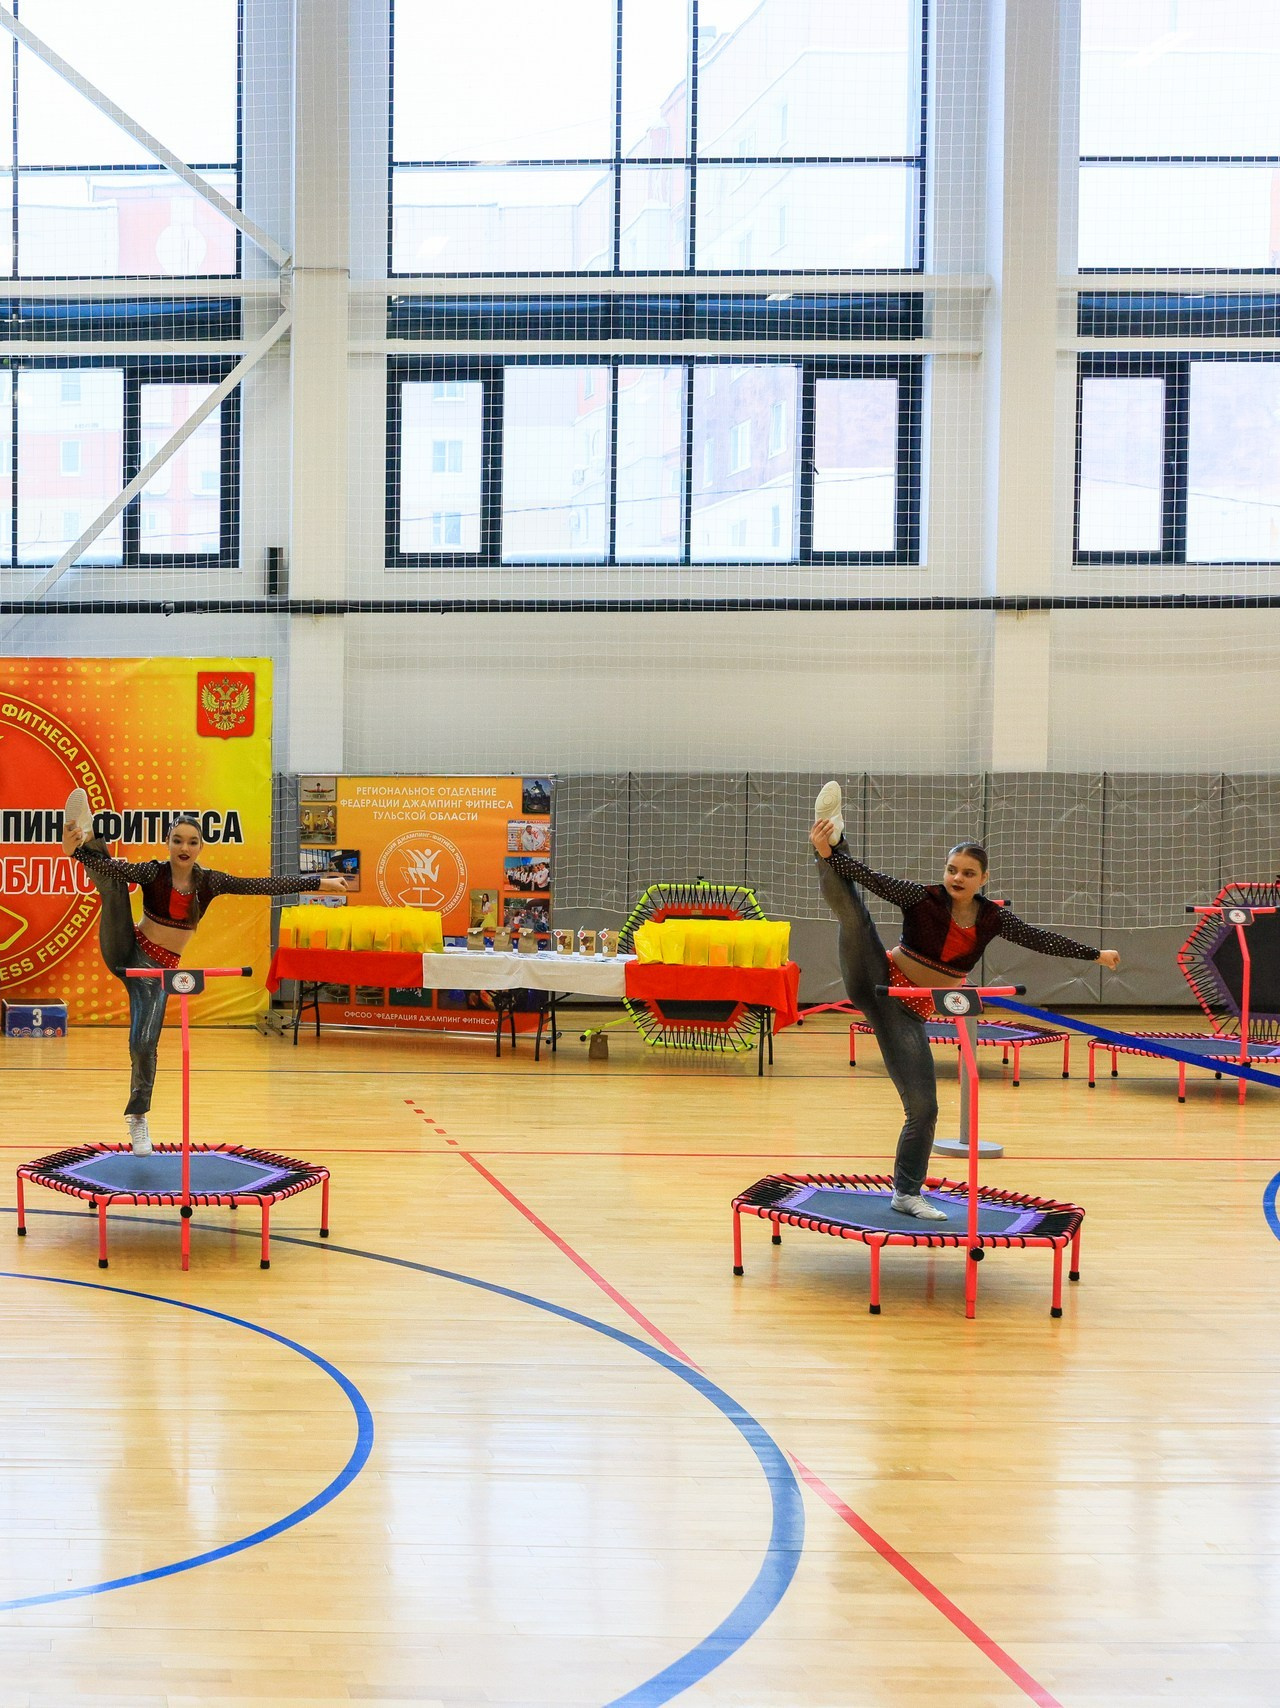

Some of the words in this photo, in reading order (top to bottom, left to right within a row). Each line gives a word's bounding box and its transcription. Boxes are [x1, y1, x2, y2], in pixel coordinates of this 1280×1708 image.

[1, 702, 80, 761] ФИТНЕСА
[76, 761, 107, 812] РОСС
[356, 786, 435, 796] РЕГИОНАЛЬНОЕ
[437, 787, 497, 797] ОТДЕЛЕНИЕ
[340, 799, 400, 809] ФЕДЕРАЦИИ
[402, 799, 463, 809] ДЖАМПИНГ
[465, 800, 514, 809] ФИТНЕСА
[373, 810, 426, 821] ТУЛЬСКОЙ
[429, 811, 478, 821] ОБЛАСТИ
[92, 808, 245, 845] ФИТНСА
[442, 882, 465, 914] FEDERATION
[38, 890, 100, 963] FEDERAT
[32, 1008, 43, 1027] 3
[344, 1011, 372, 1019] ОФСОО
[419, 1014, 461, 1023] ДЖАМПИНГ
